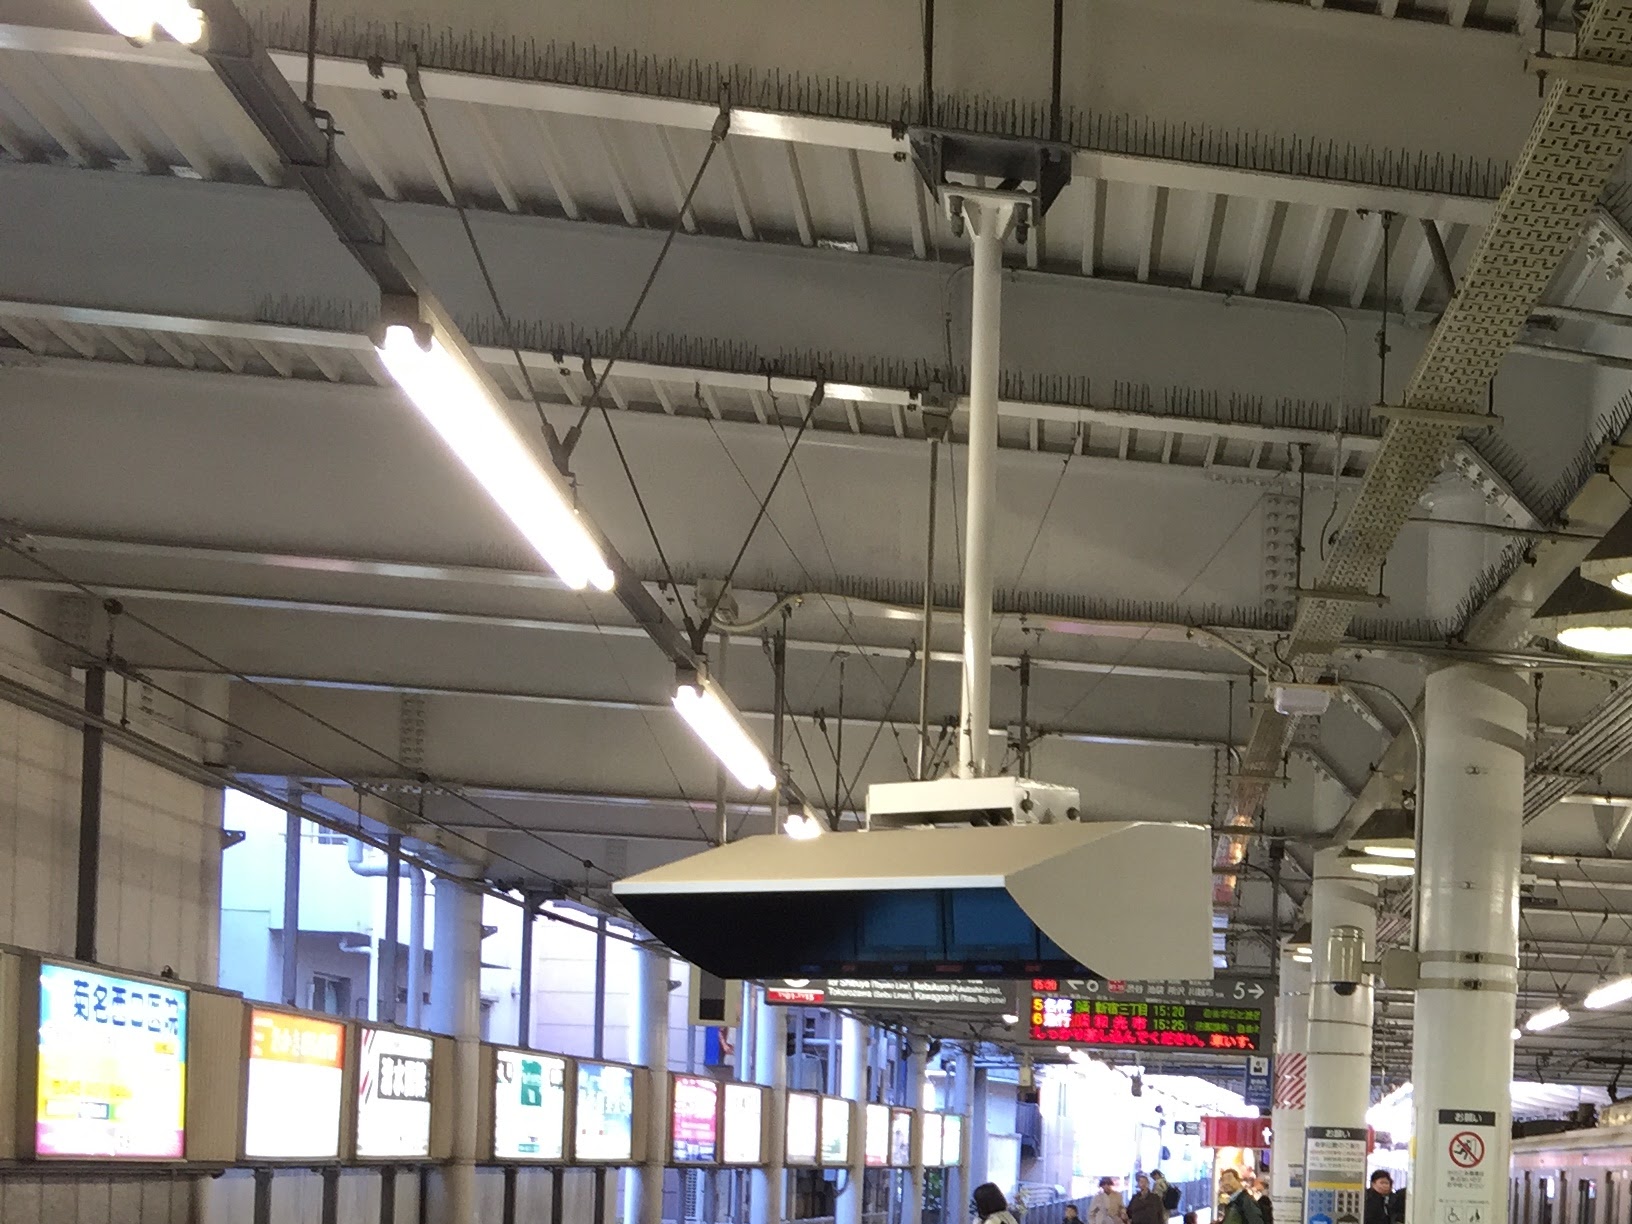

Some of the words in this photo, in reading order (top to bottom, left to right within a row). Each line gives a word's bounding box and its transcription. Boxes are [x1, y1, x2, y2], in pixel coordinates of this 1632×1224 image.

[1233, 982, 1245, 1000] 5
[1033, 998, 1043, 1011] 5
[1153, 1005, 1185, 1018] 15:20
[1032, 1012, 1043, 1025] 6
[1153, 1018, 1185, 1031] 15:25
